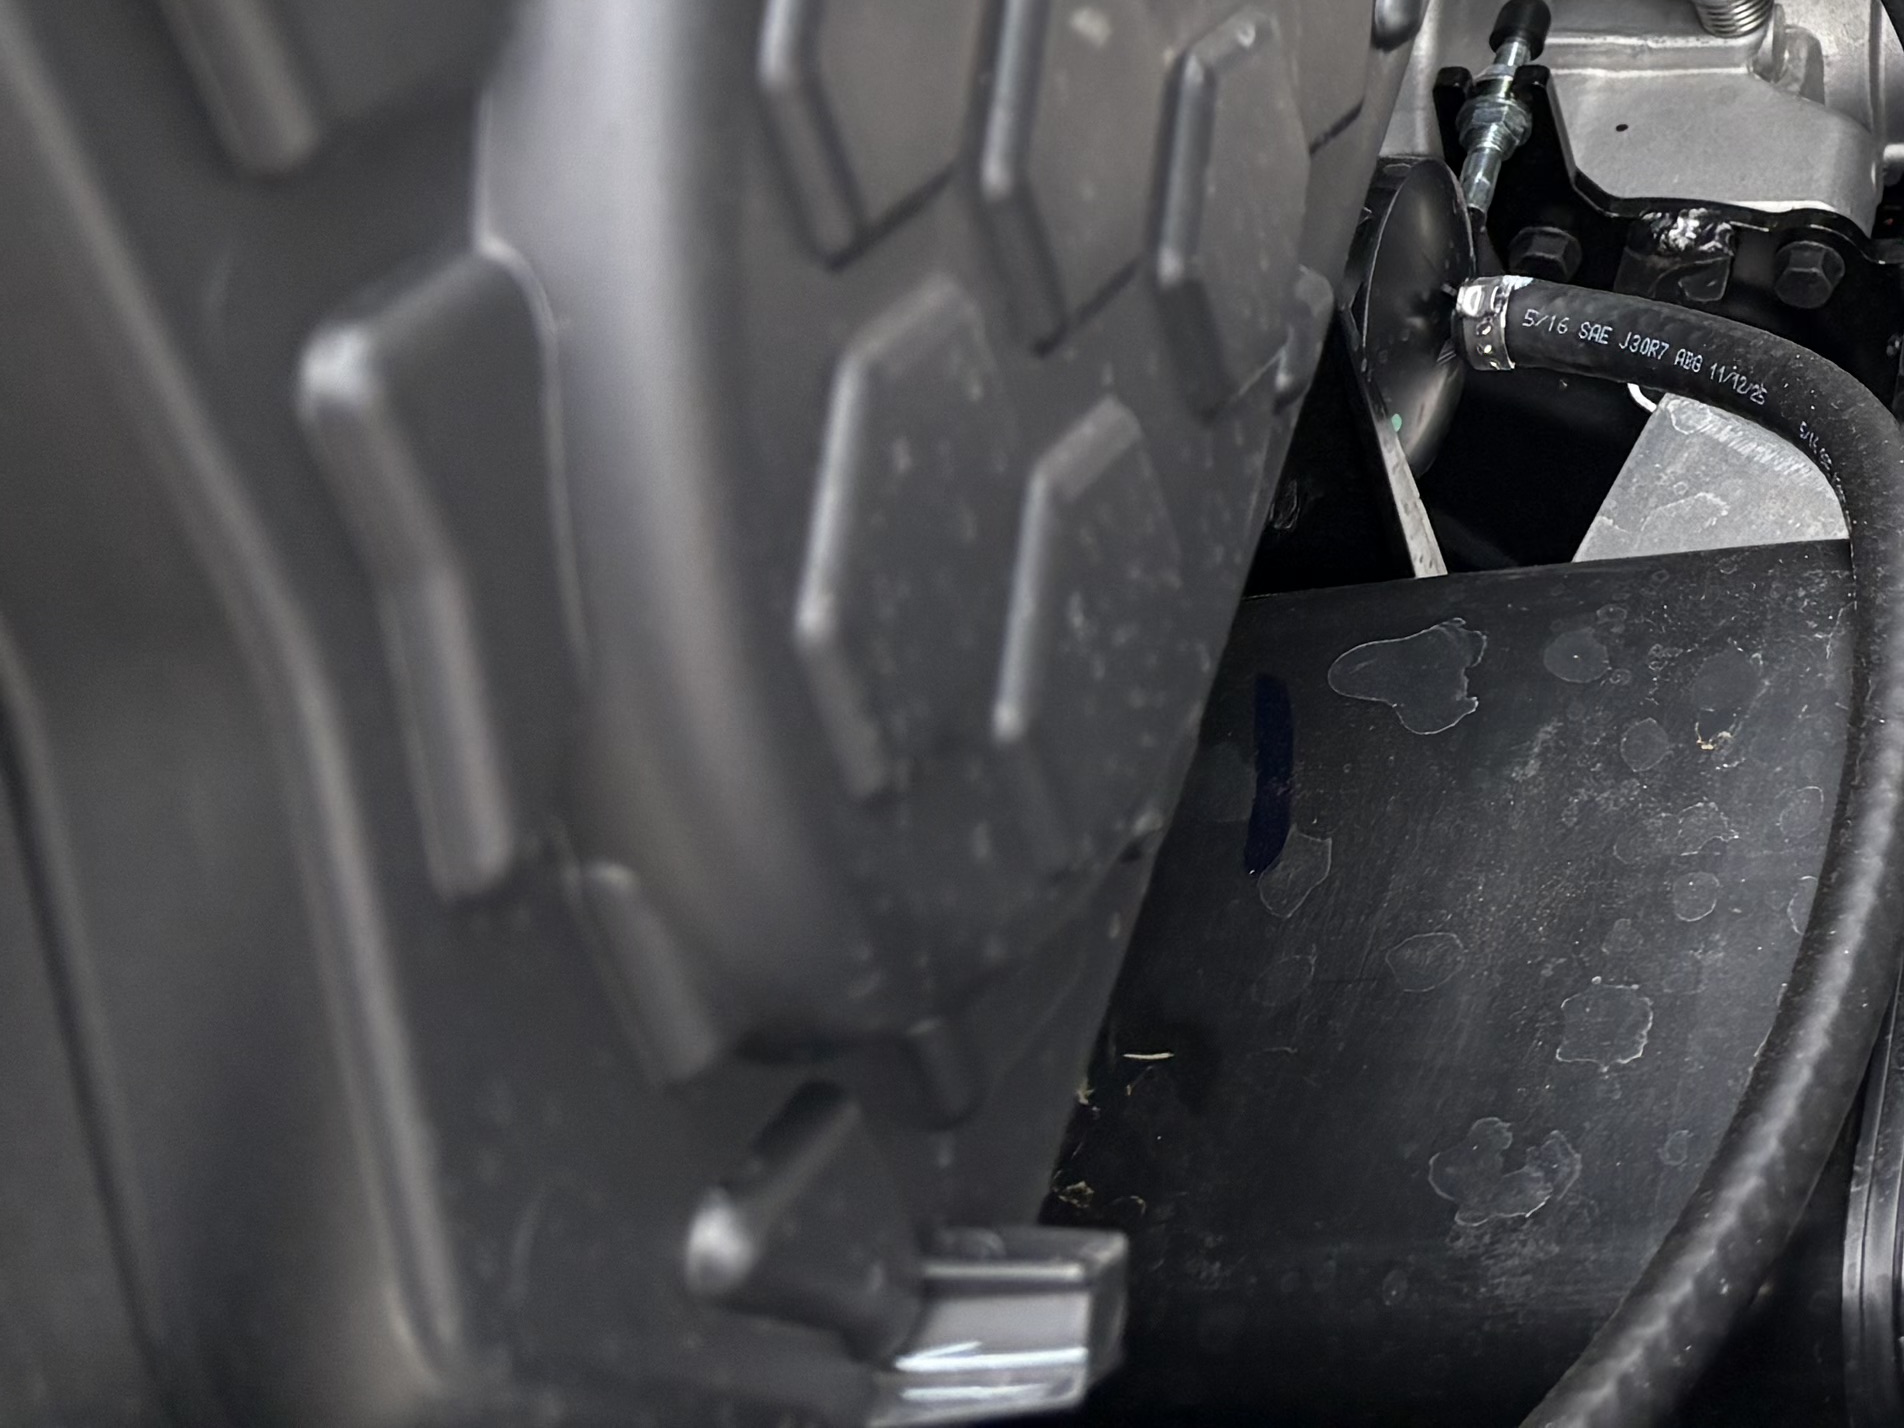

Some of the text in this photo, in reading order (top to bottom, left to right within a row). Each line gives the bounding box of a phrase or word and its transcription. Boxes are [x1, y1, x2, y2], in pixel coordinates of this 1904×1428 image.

[1522, 309, 1569, 334] 5/16
[1579, 321, 1613, 345] SAE
[1619, 332, 1669, 360] J30R7
